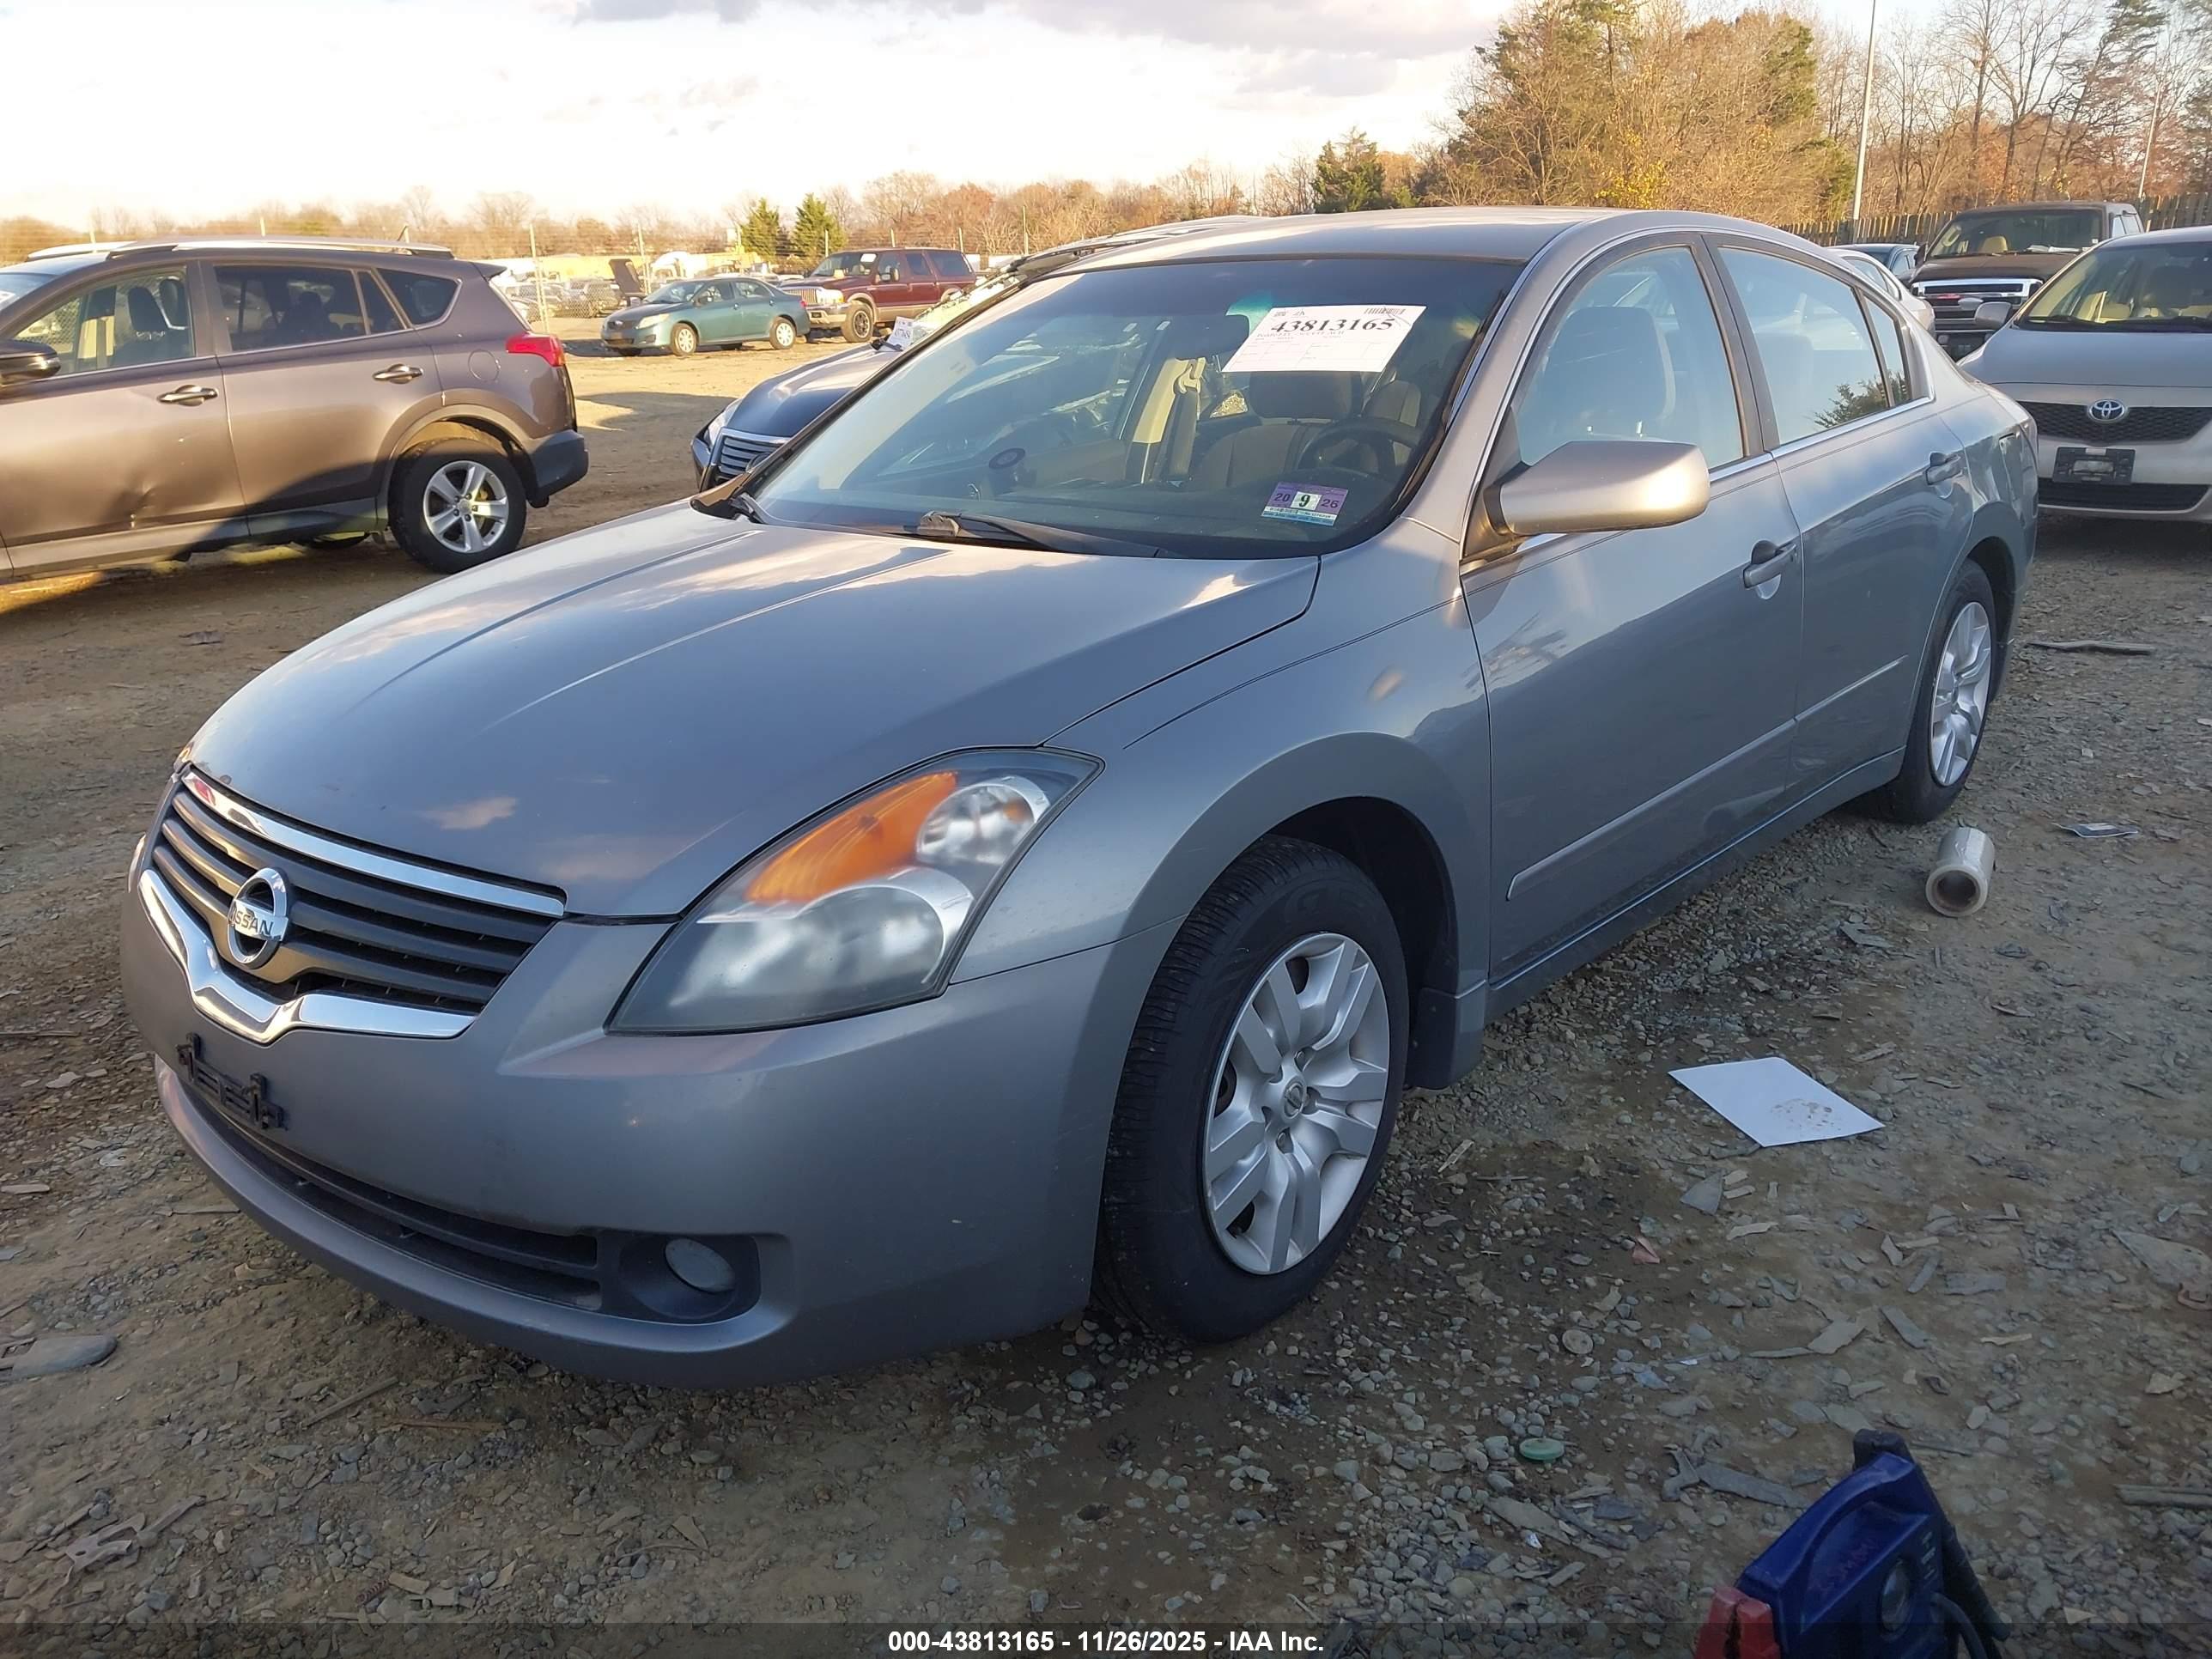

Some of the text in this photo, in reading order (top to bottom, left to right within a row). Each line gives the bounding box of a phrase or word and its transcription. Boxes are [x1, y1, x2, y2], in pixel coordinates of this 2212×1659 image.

[1271, 317, 1395, 332] 43813165
[1273, 492, 1340, 508] 20 9 26
[229, 907, 273, 935] SSAN
